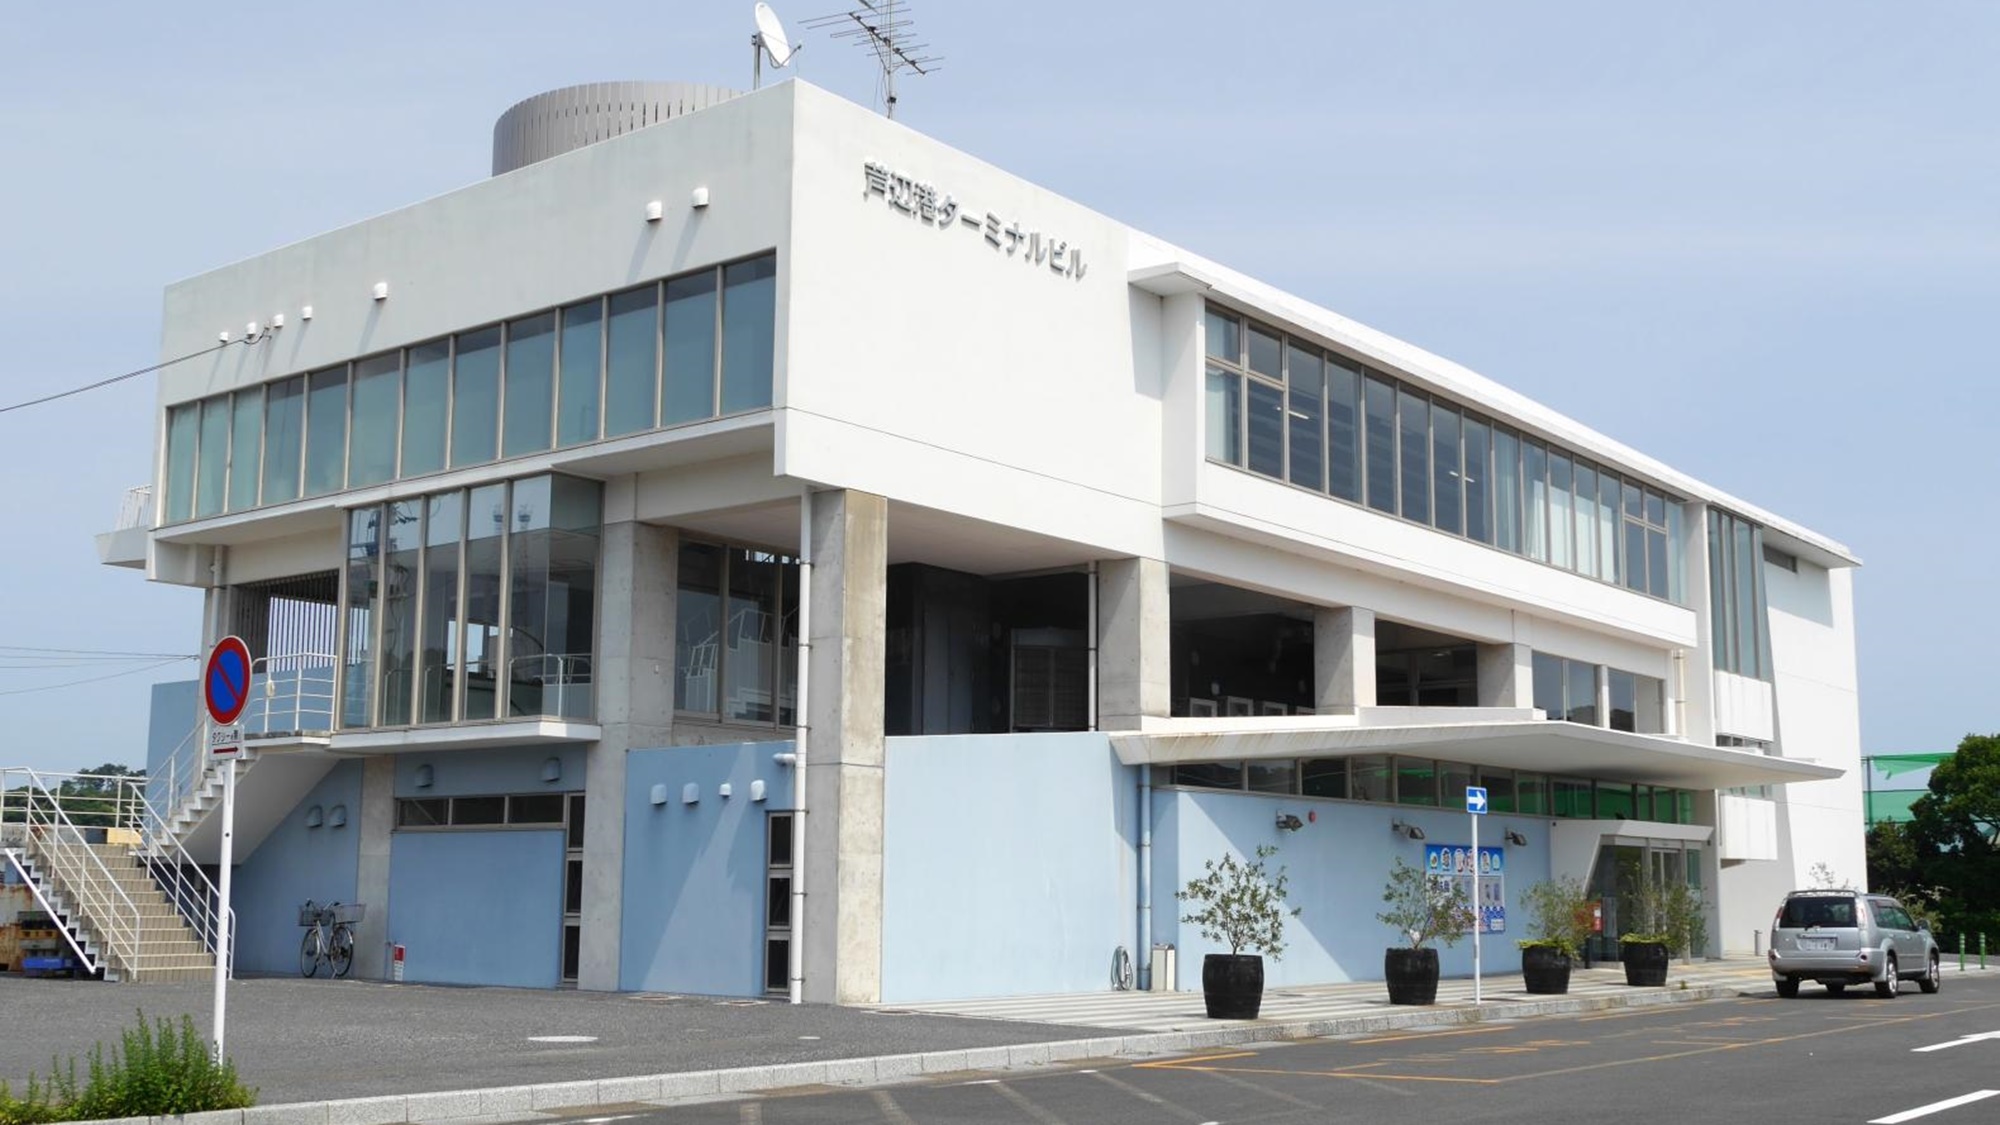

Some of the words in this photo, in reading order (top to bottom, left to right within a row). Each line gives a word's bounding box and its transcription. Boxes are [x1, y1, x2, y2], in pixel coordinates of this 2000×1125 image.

[864, 162, 1087, 280] 芦辺港ターミナルビル
